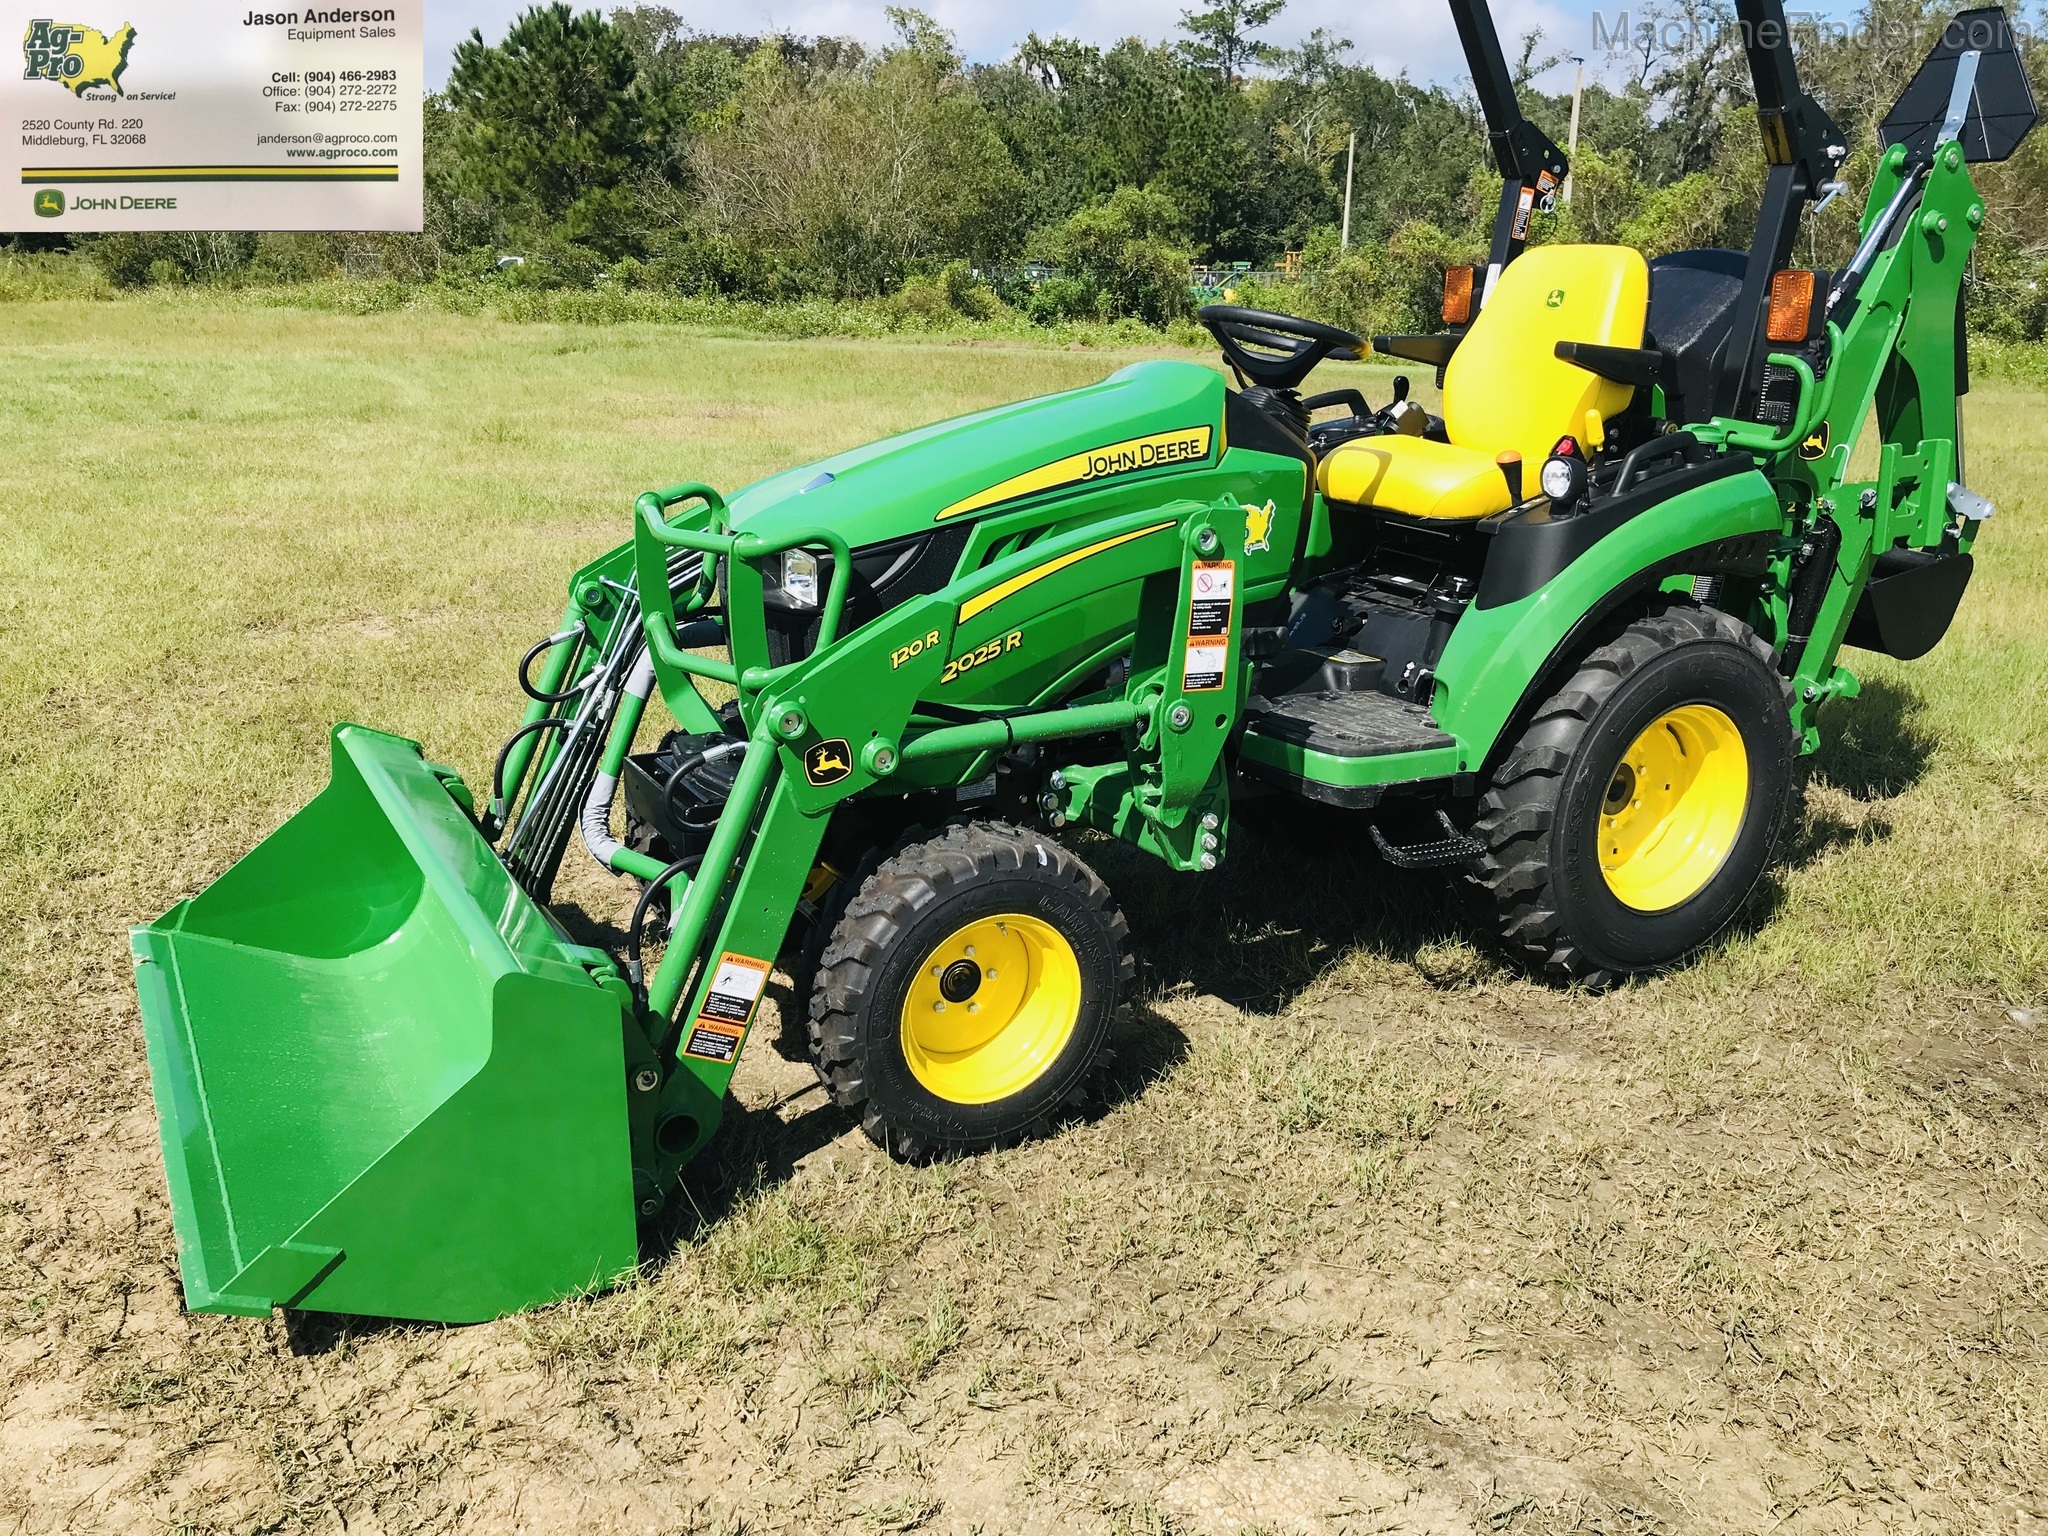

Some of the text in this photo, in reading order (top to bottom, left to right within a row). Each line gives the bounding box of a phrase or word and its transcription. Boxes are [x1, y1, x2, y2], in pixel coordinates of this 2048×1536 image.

[1082, 439, 1202, 478] JOHN DEERE
[890, 629, 941, 670] 120 R
[1195, 638, 1226, 646] WARNING
[940, 630, 1023, 685] 2025 R
[734, 957, 765, 970] WARNING
[707, 1023, 739, 1035] WARNING
